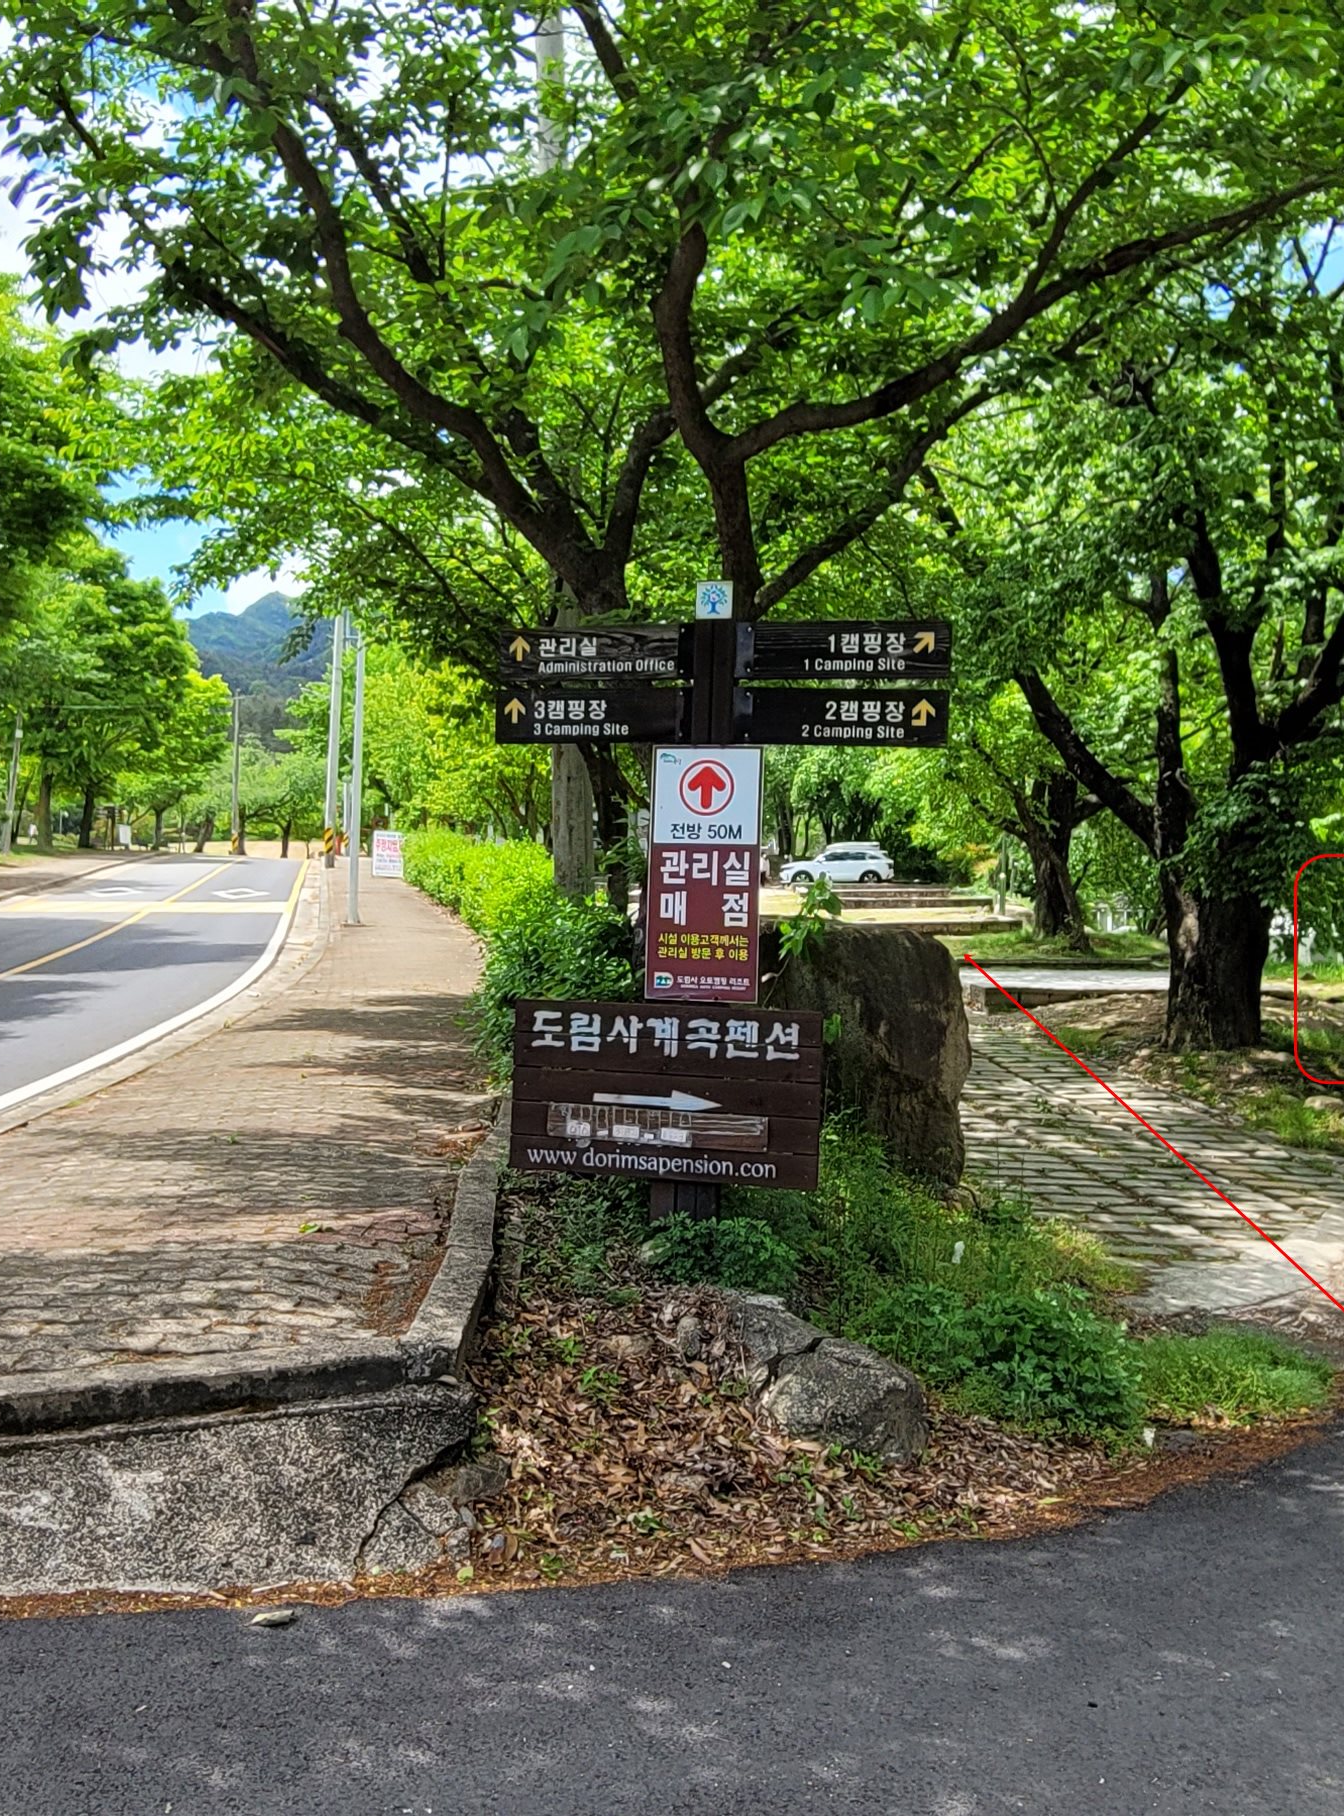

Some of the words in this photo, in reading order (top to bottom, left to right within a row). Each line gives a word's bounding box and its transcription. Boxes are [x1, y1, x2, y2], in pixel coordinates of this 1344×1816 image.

[538, 637, 597, 658] 관리실
[828, 632, 906, 654] 1캠핑장
[537, 660, 632, 674] Administration
[635, 659, 675, 671] Office
[804, 658, 809, 671] 1
[815, 658, 873, 672] Camping
[877, 657, 906, 671] Site
[534, 700, 607, 720] 3캠핑장
[825, 701, 905, 722] 2캠핑장
[533, 724, 541, 736] 3
[544, 723, 600, 737] Camping
[603, 723, 629, 736] Site
[801, 725, 810, 737] 2
[814, 724, 873, 739] Camping
[876, 725, 905, 738] Site
[670, 823, 702, 840] 전방
[707, 824, 742, 840] 50M
[660, 850, 750, 887] 관리실
[657, 933, 678, 945] 시설
[680, 933, 749, 947] 이용고객께서는
[657, 947, 688, 959] 관리실
[691, 948, 712, 960] 방문
[715, 948, 725, 961] 후
[728, 949, 749, 961] 이용
[530, 1010, 800, 1061] 도림사계곡펜션
